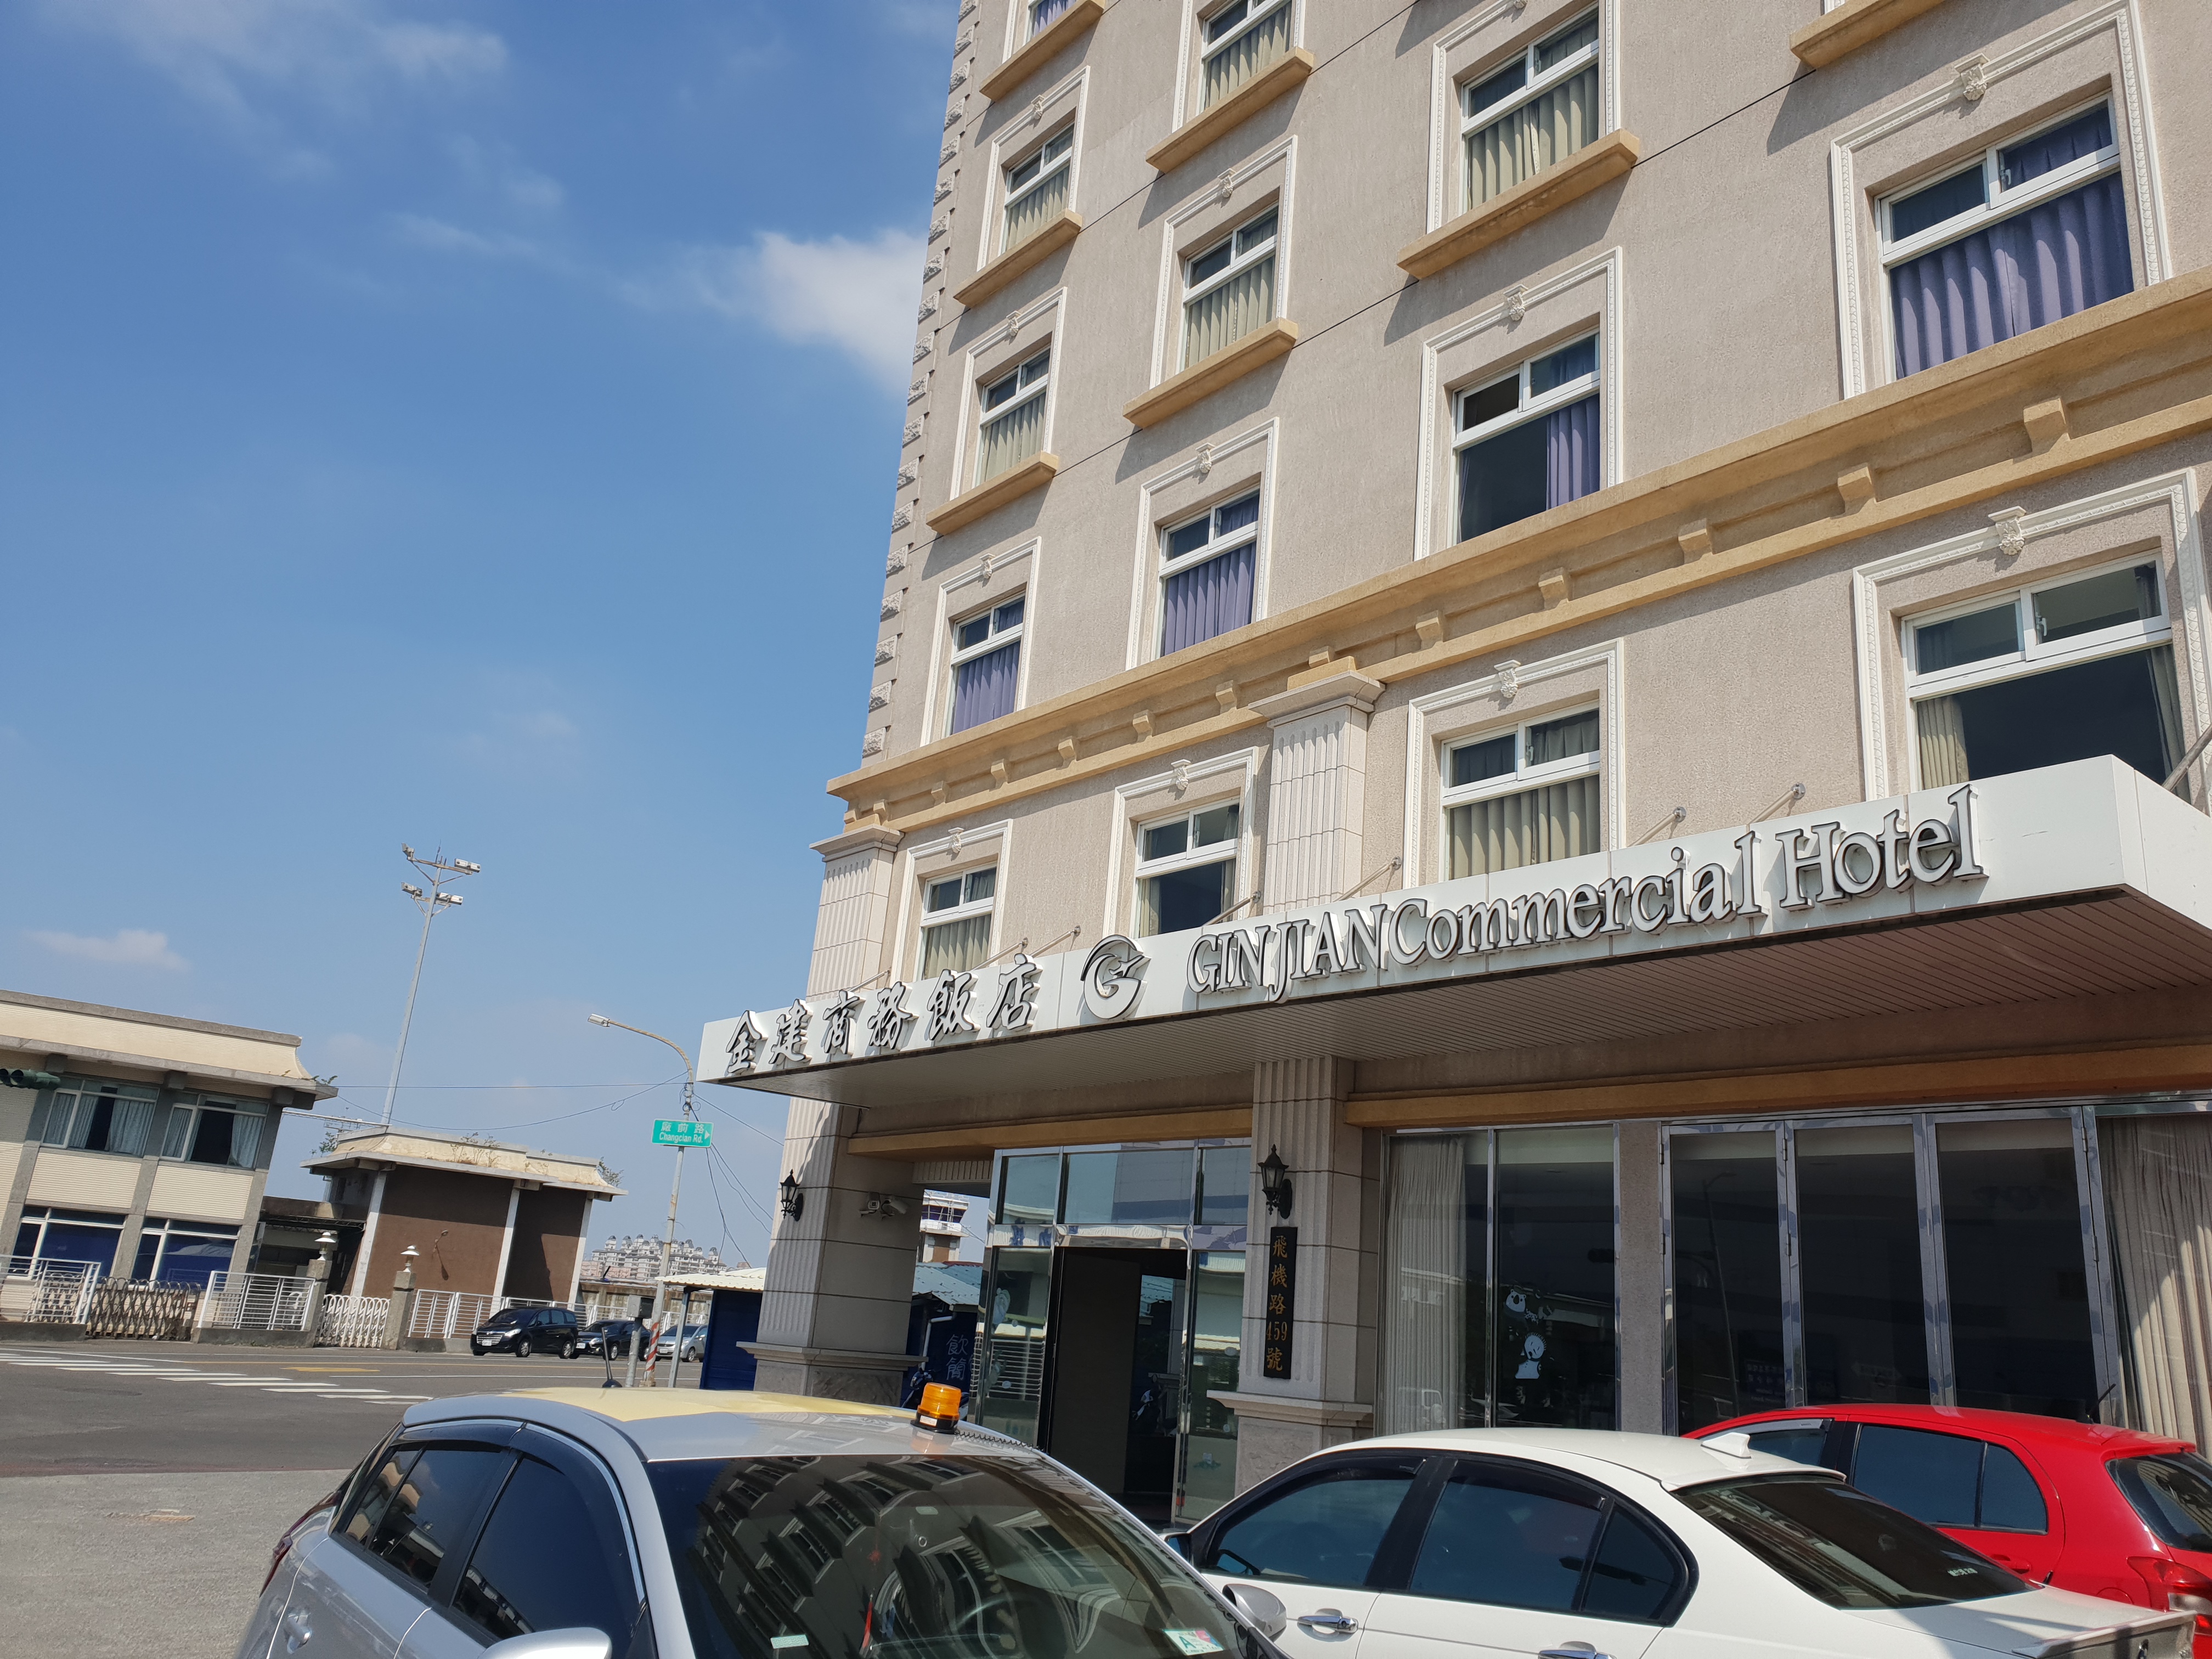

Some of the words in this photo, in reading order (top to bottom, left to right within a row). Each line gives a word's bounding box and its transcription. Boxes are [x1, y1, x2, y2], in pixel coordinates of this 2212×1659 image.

[1775, 784, 1988, 910] Hotel
[726, 952, 1042, 1075] 金建商務飯店
[659, 1132, 691, 1143] Changcian
[661, 1122, 704, 1133] 廠前路
[1266, 1235, 1288, 1371] 飛機路459號
